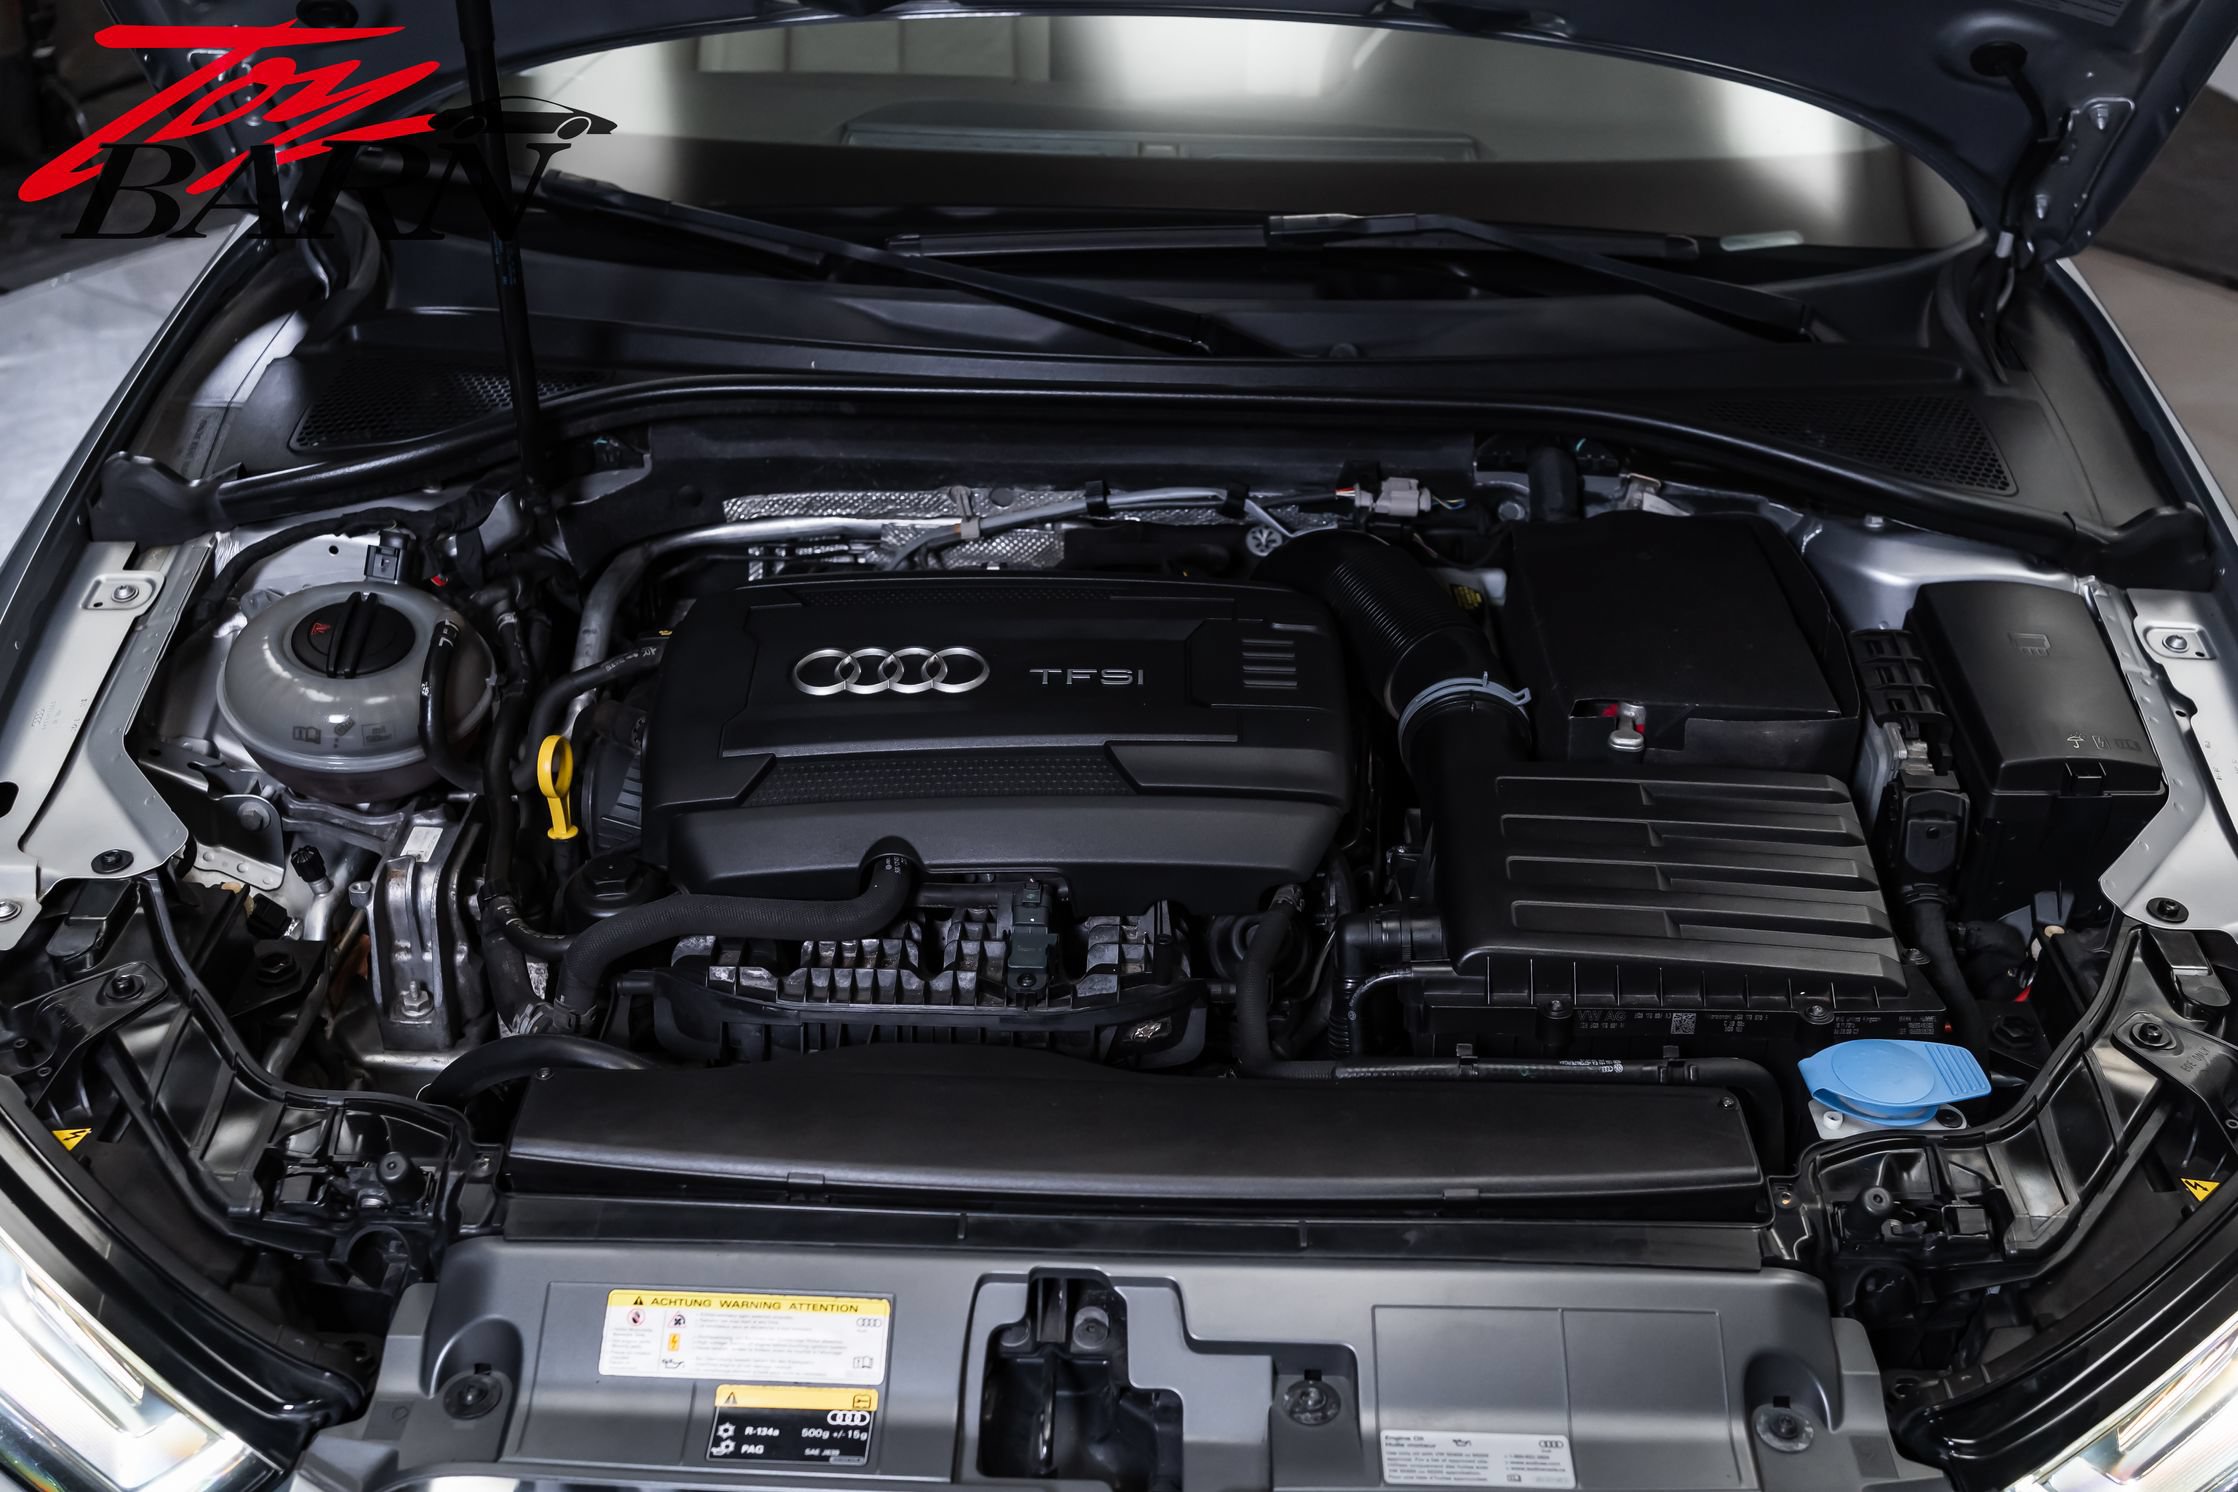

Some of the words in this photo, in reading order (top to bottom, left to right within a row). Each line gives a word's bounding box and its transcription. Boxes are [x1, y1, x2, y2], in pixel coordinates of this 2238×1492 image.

[1029, 668, 1144, 685] TFSI
[651, 1297, 712, 1308] ACHTUNG
[719, 1299, 781, 1311] WARNING
[789, 1302, 859, 1313] ATTENTION
[744, 1426, 780, 1437] R-134a
[801, 1428, 830, 1440] 500g
[832, 1429, 846, 1439] +/-
[847, 1430, 868, 1441] 15g
[740, 1444, 765, 1455] PAG
